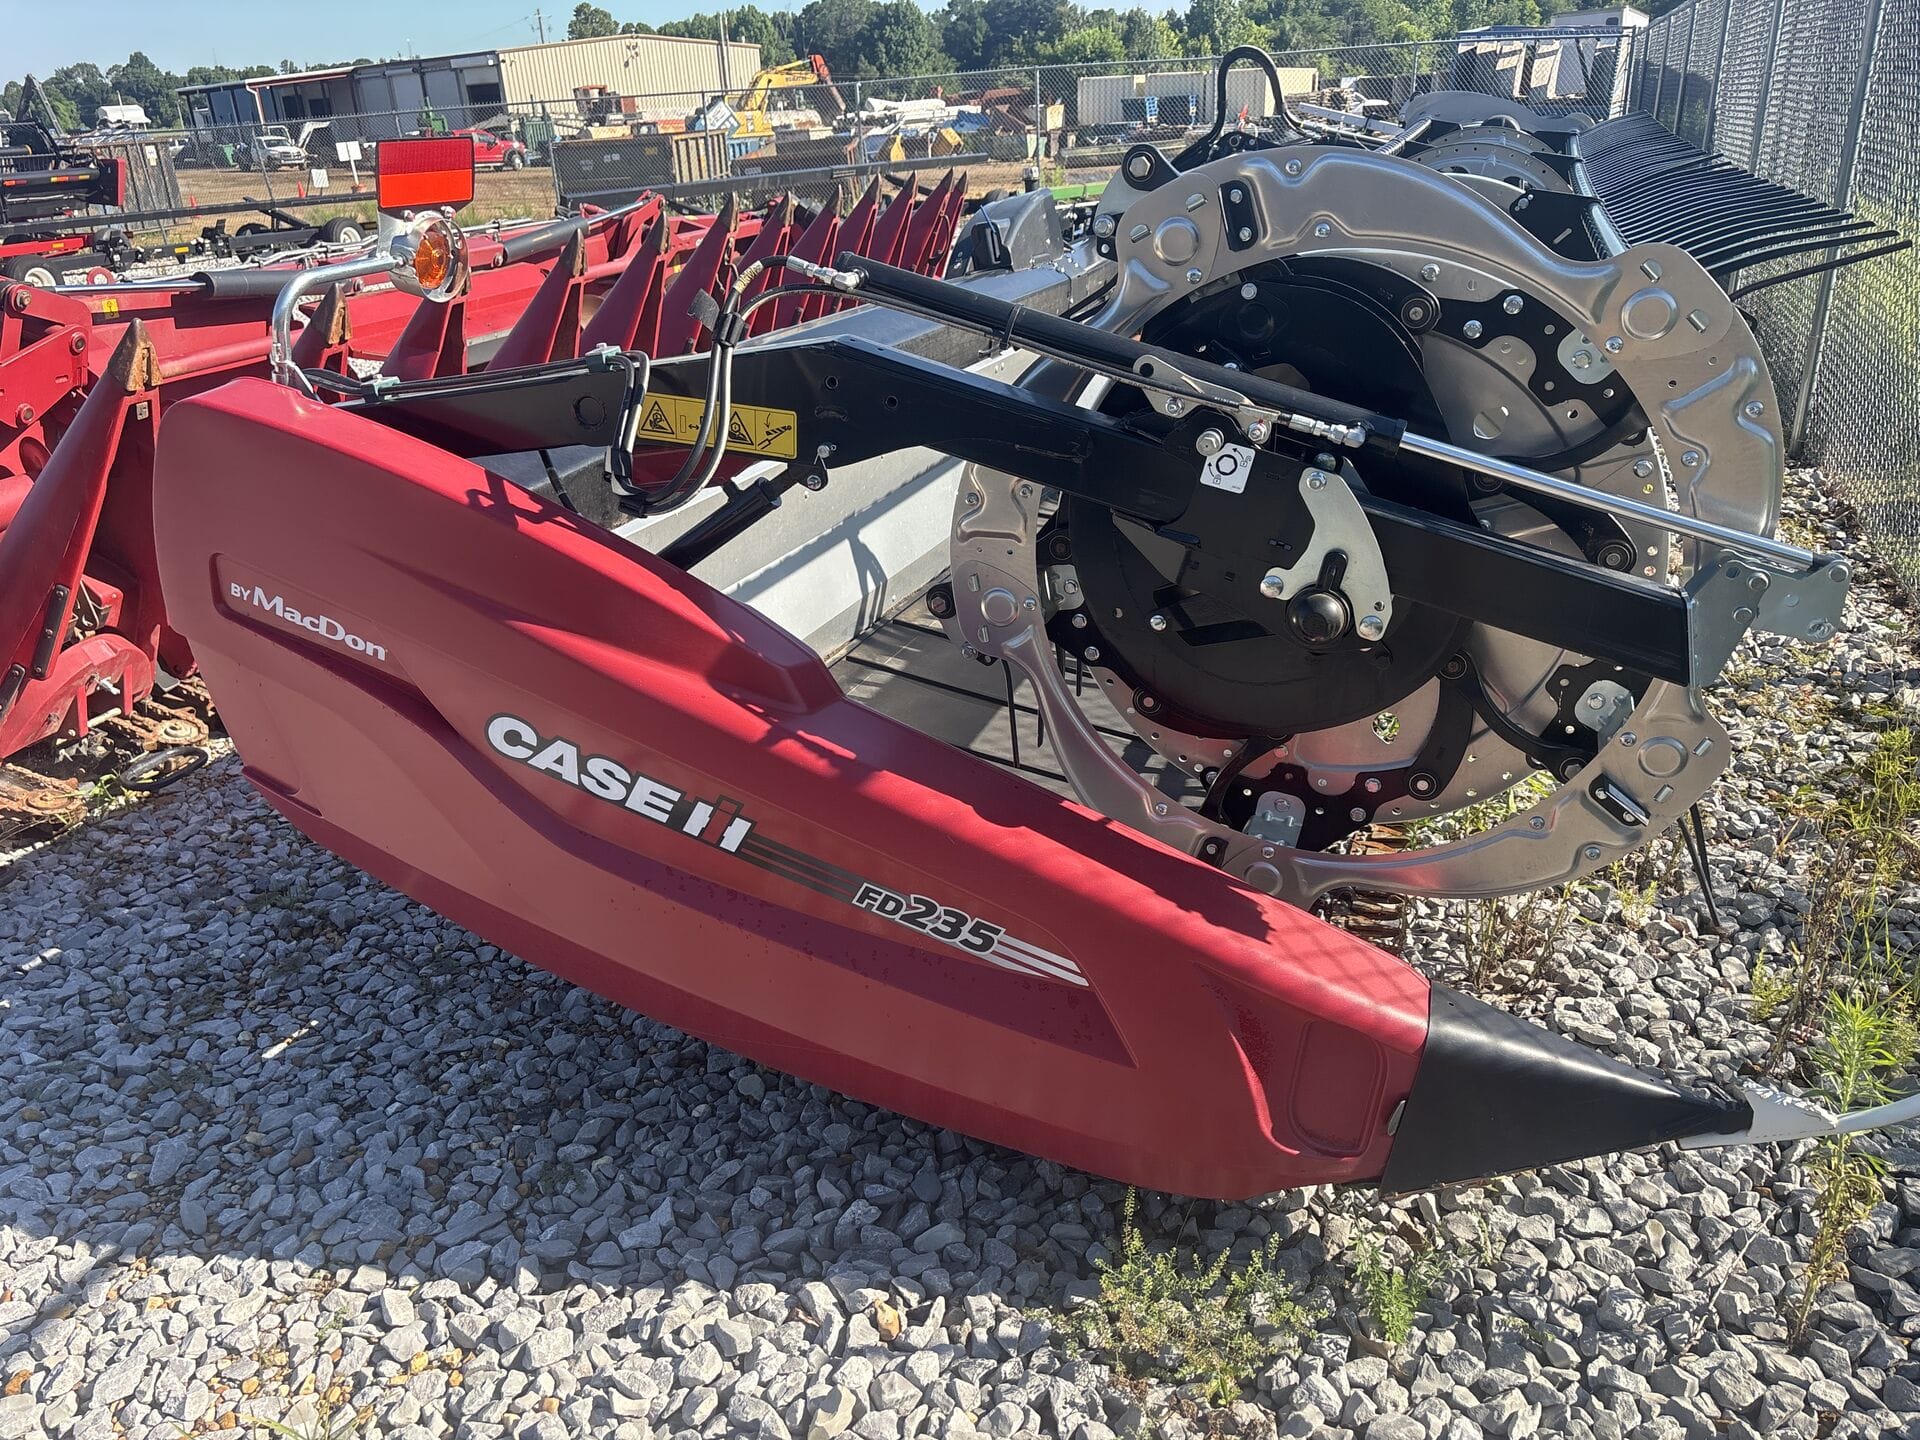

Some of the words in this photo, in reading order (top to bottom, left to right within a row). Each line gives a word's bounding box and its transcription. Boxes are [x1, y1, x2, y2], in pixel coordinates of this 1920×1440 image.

[230, 582, 251, 601] BY
[252, 585, 387, 662] MacDon
[487, 715, 683, 825] CASE
[853, 883, 1005, 955] FD235
